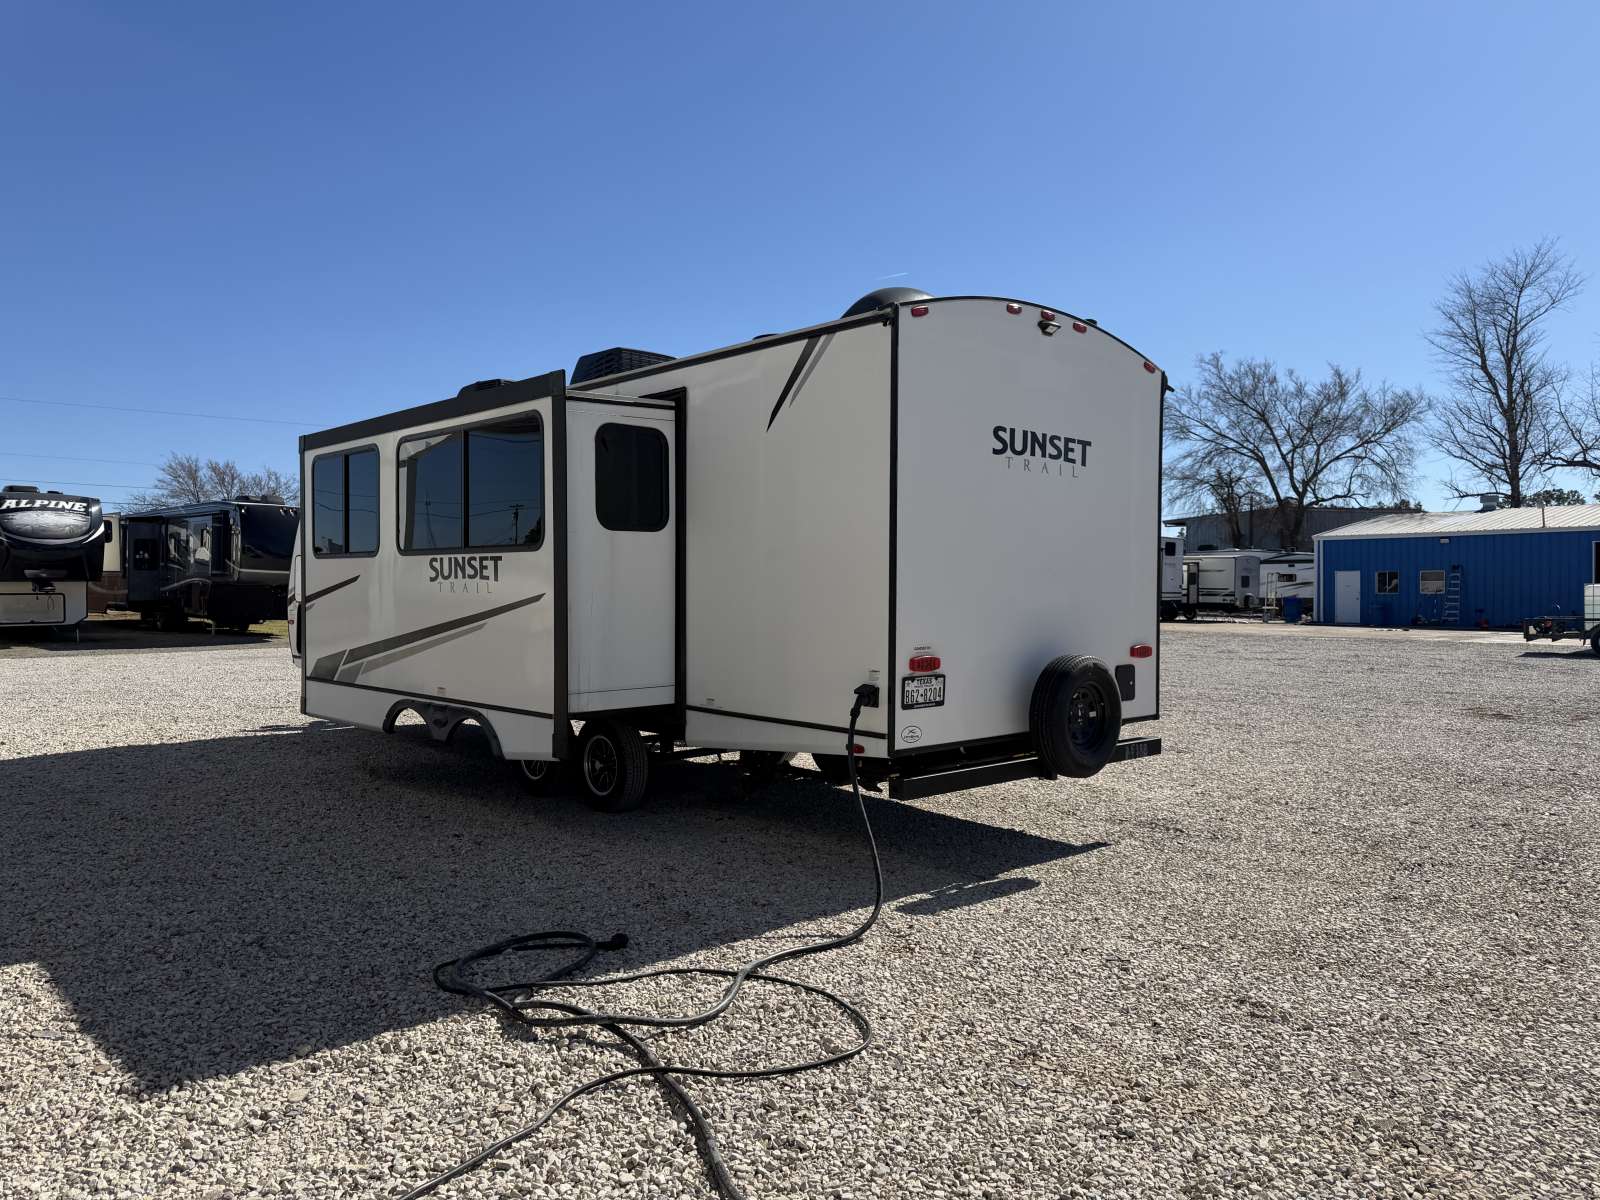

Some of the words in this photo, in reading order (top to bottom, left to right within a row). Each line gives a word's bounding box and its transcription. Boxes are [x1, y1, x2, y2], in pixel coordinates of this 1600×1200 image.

[992, 425, 1092, 467] SUNSET
[1005, 457, 1078, 478] TRAIL
[0, 499, 87, 512] ALPINE
[429, 555, 502, 582] SUNSET
[438, 582, 493, 593] TRAIL
